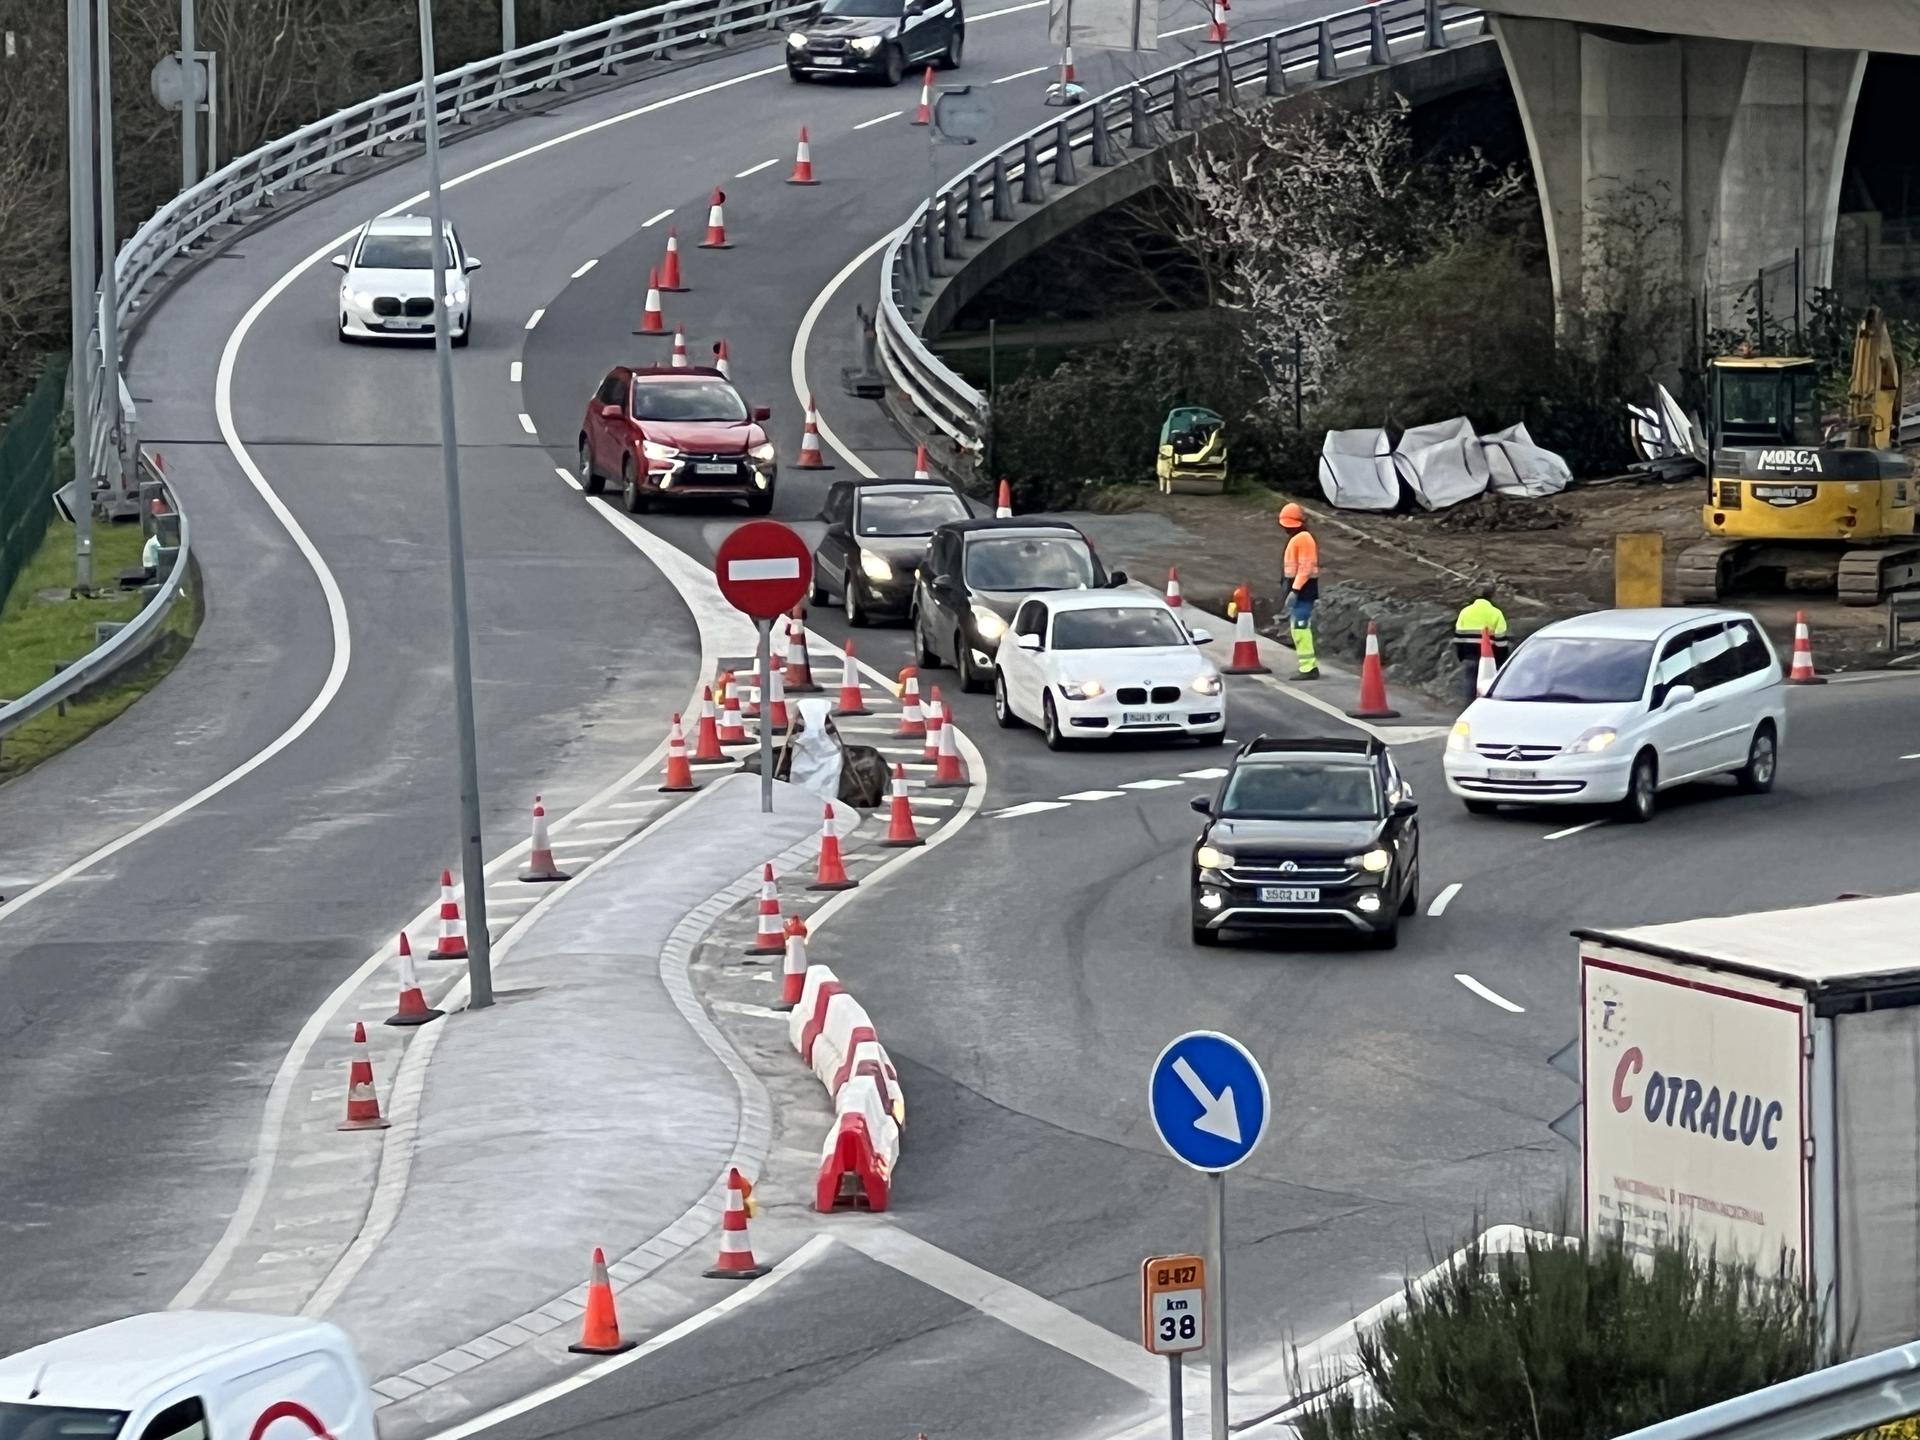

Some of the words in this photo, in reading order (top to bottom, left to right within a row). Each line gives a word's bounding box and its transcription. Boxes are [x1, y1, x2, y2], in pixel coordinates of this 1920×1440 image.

[1757, 450, 1823, 473] MORGA
[1166, 1298, 1188, 1311] km
[1160, 1314, 1196, 1342] 38
